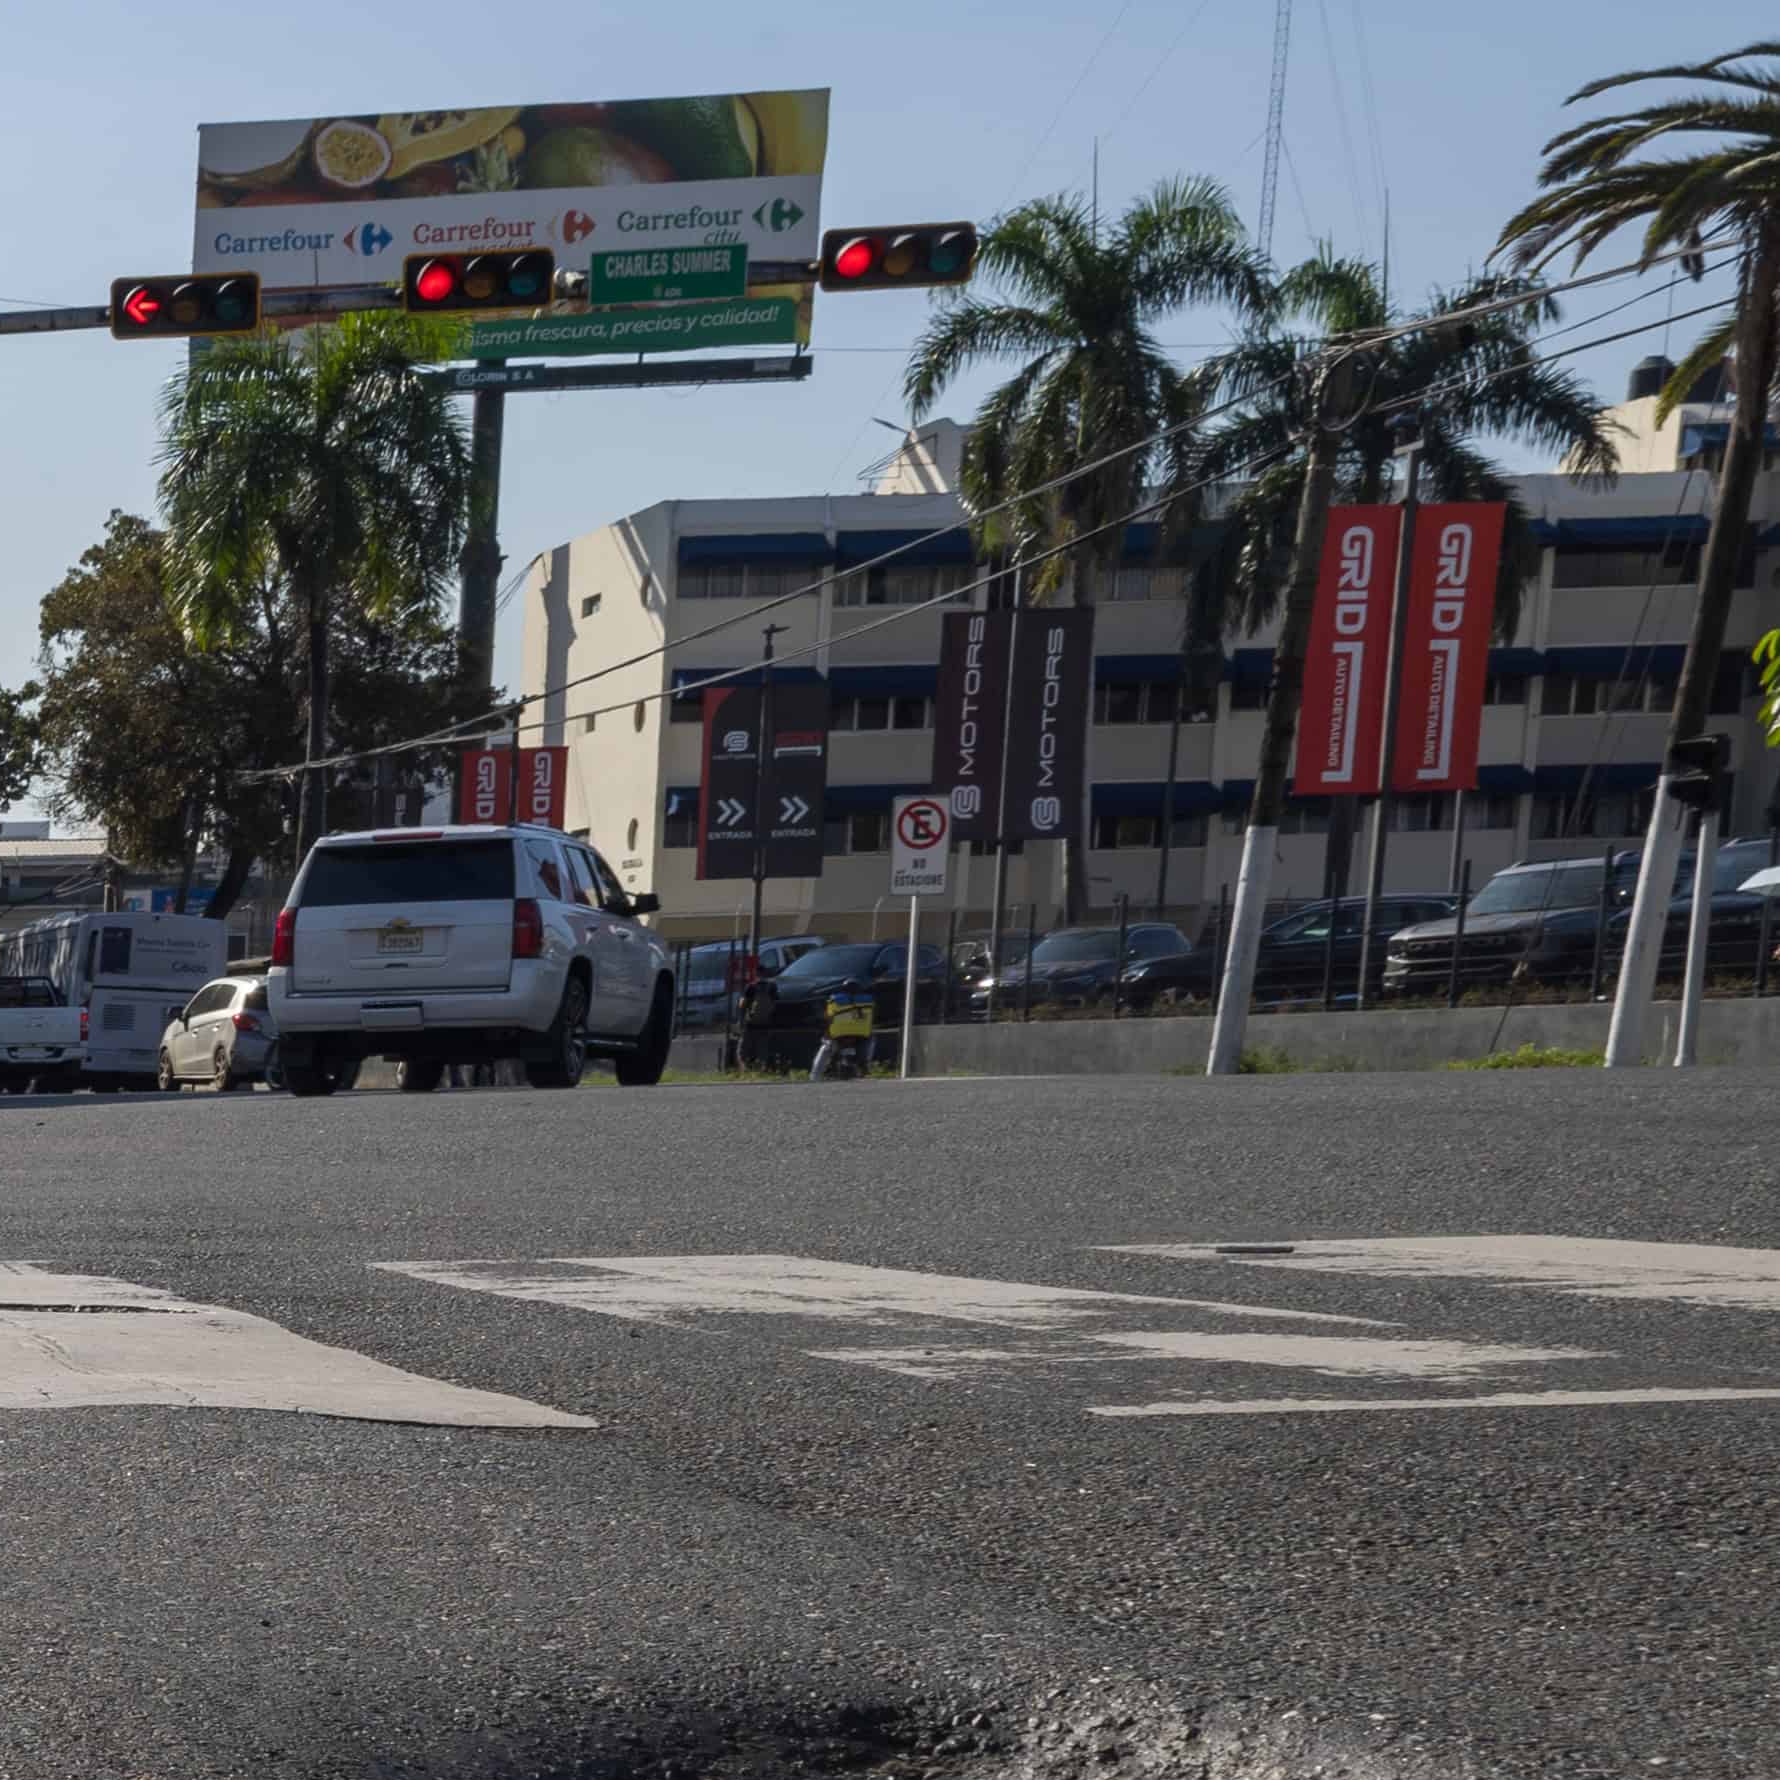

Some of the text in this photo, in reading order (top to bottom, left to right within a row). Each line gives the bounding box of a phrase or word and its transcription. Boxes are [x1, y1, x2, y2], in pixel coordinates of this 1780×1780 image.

[214, 228, 335, 255] Carrefour
[413, 217, 537, 246] Carrefour
[616, 206, 743, 232] Carrefour
[703, 230, 741, 246] city
[605, 249, 731, 279] CHARLES SUMMER
[525, 318, 608, 344] frescura,
[610, 313, 682, 344] precios
[683, 318, 700, 333] y
[699, 305, 780, 327] calidad!
[1336, 525, 1374, 635] GRID
[1432, 523, 1472, 632] GRID
[958, 615, 985, 776] MOTORS
[1037, 627, 1064, 787] MOTORS
[1328, 658, 1347, 767] AUTO DETAILING
[1423, 655, 1444, 765] AUTO DETAILING
[475, 755, 496, 819] GRID
[532, 752, 553, 814] GRID
